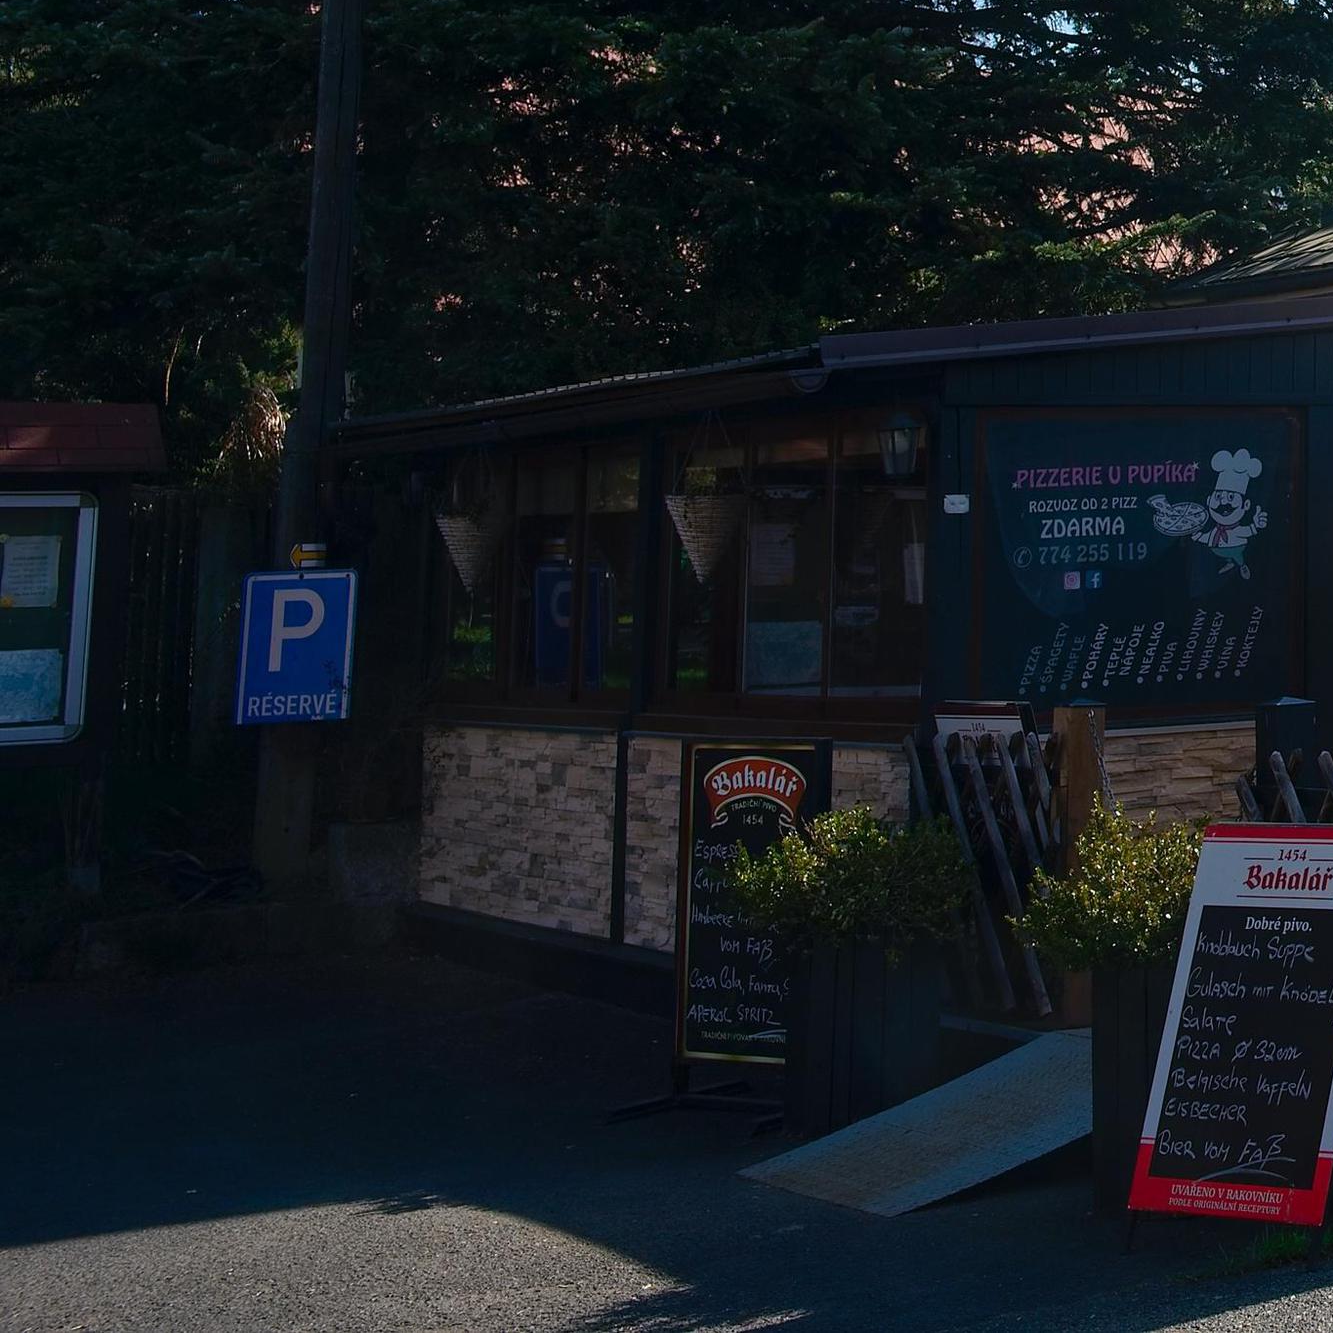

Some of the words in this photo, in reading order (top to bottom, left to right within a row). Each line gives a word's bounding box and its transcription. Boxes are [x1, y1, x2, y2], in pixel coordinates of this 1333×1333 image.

[1015, 466, 1102, 489] PIZZERIE
[1108, 466, 1121, 485] U
[1127, 460, 1196, 484] PUPÍKA
[1028, 498, 1078, 513] ROZVOZ
[1080, 497, 1097, 510] OD
[1100, 497, 1109, 510] 2
[1112, 496, 1138, 509] PIZZ
[1040, 516, 1125, 539] ZDARMA
[1038, 545, 1072, 565] 774
[1077, 543, 1110, 563] 255
[1117, 542, 1148, 561] 119
[268, 589, 325, 672] P
[1138, 620, 1165, 675] NEALKO
[1178, 608, 1207, 671] LIHOVINY
[1196, 610, 1225, 671] WHISKEY
[1236, 605, 1265, 668] KOKTEJLY
[1020, 644, 1043, 686] PIZZA
[1040, 621, 1070, 684] ŠPAGETY
[1060, 634, 1086, 682] WAFLE
[1082, 622, 1109, 681] POHÁRY
[1104, 635, 1127, 678] TEPLÉ
[1118, 623, 1145, 676] NÁPOJE
[1157, 641, 1179, 673] PIVA
[1216, 635, 1237, 670] VÍNA
[247, 689, 337, 718] RÉSERVÉ
[711, 763, 800, 798] Bakalář
[742, 814, 764, 826] 1454
[1278, 849, 1308, 861] 1454
[1243, 865, 1333, 891] Bakalář
[1245, 916, 1281, 931] Dobré
[1282, 917, 1313, 935] pivo.
[1168, 1197, 1192, 1207] PODLE
[1193, 1199, 1238, 1212] ORIGINÁLNÍ
[1237, 1203, 1282, 1216] RECEPTURY
[1171, 1184, 1216, 1200] UVAŘENO
[1218, 1188, 1226, 1199] V
[1226, 1188, 1284, 1204] RAKOVNÍKU
